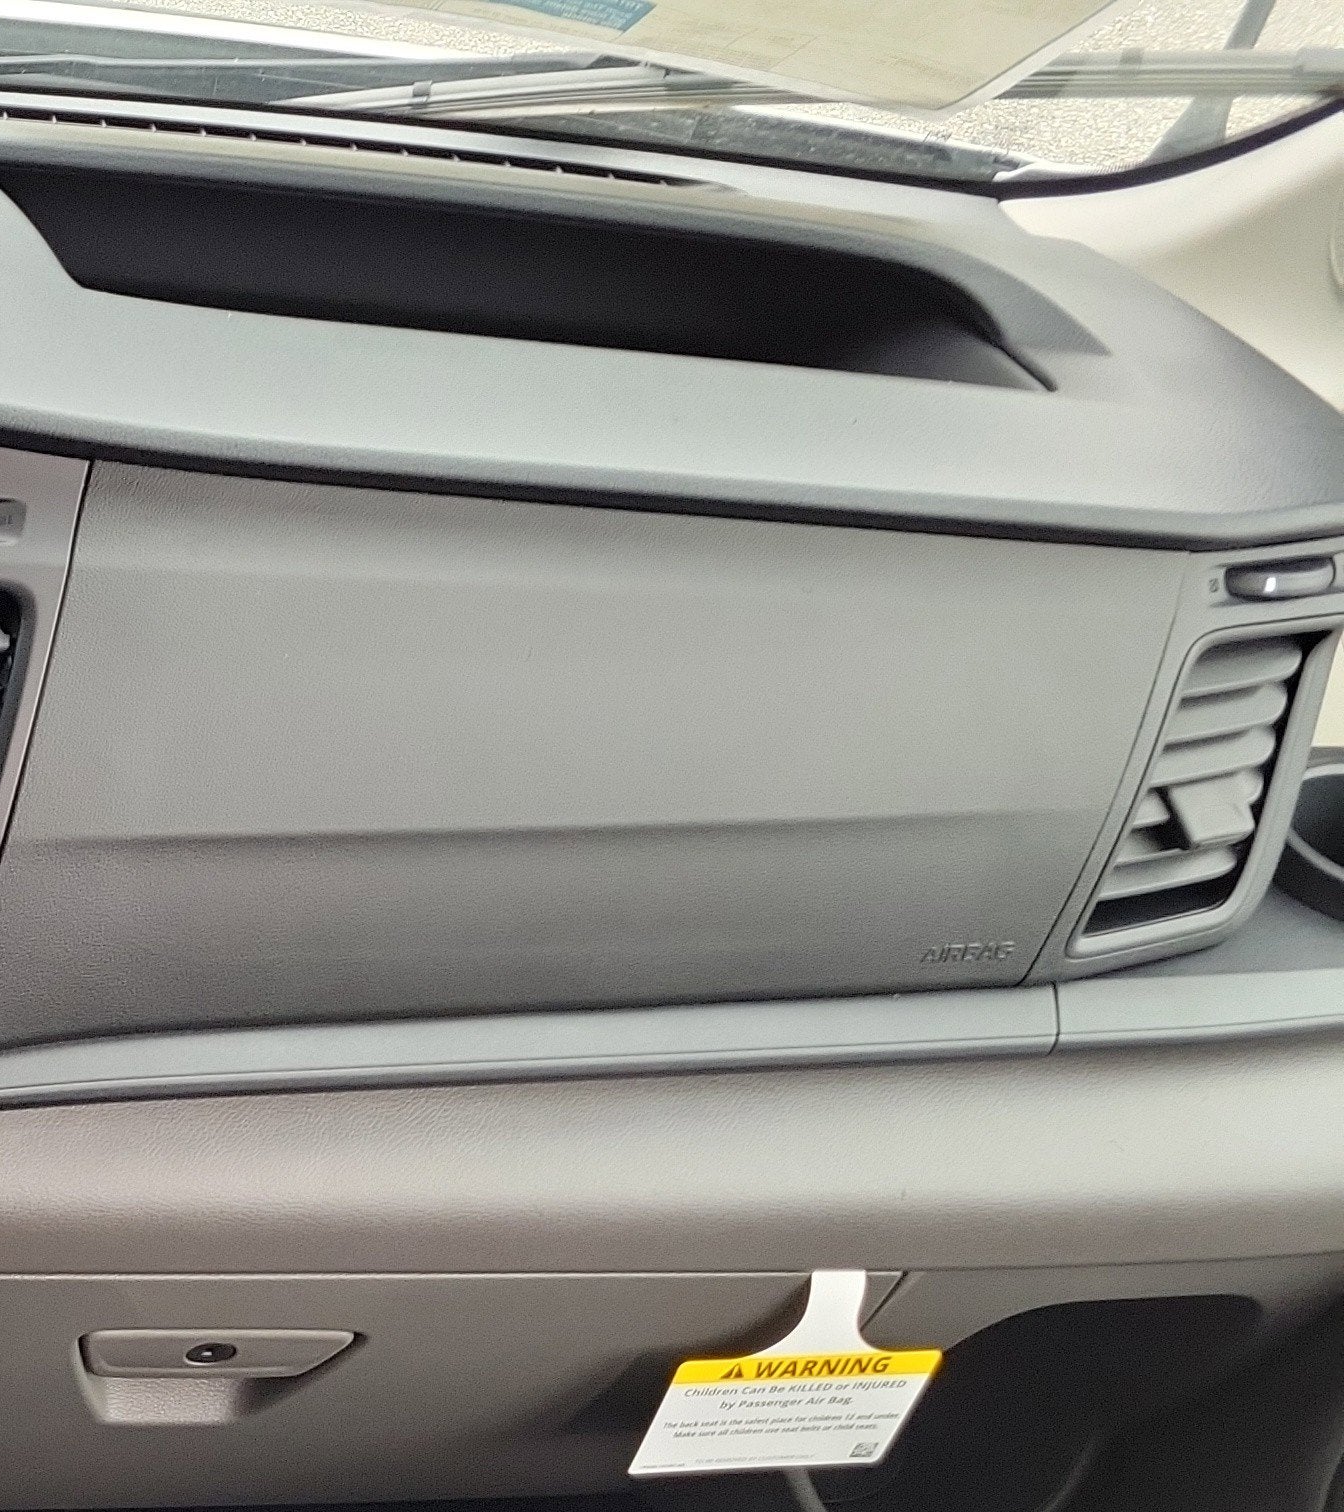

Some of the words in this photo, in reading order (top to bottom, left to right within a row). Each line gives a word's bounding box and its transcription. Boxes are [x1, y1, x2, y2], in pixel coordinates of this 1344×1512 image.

[754, 1356, 892, 1378] WARNING
[684, 1387, 738, 1397] Children
[742, 1385, 766, 1395] Can
[769, 1384, 785, 1393] Be
[788, 1382, 833, 1393] KILLED
[835, 1383, 850, 1391] or
[852, 1380, 907, 1391] INJURED
[719, 1401, 735, 1411] by
[738, 1398, 802, 1409] Passenger
[805, 1396, 826, 1405] Air
